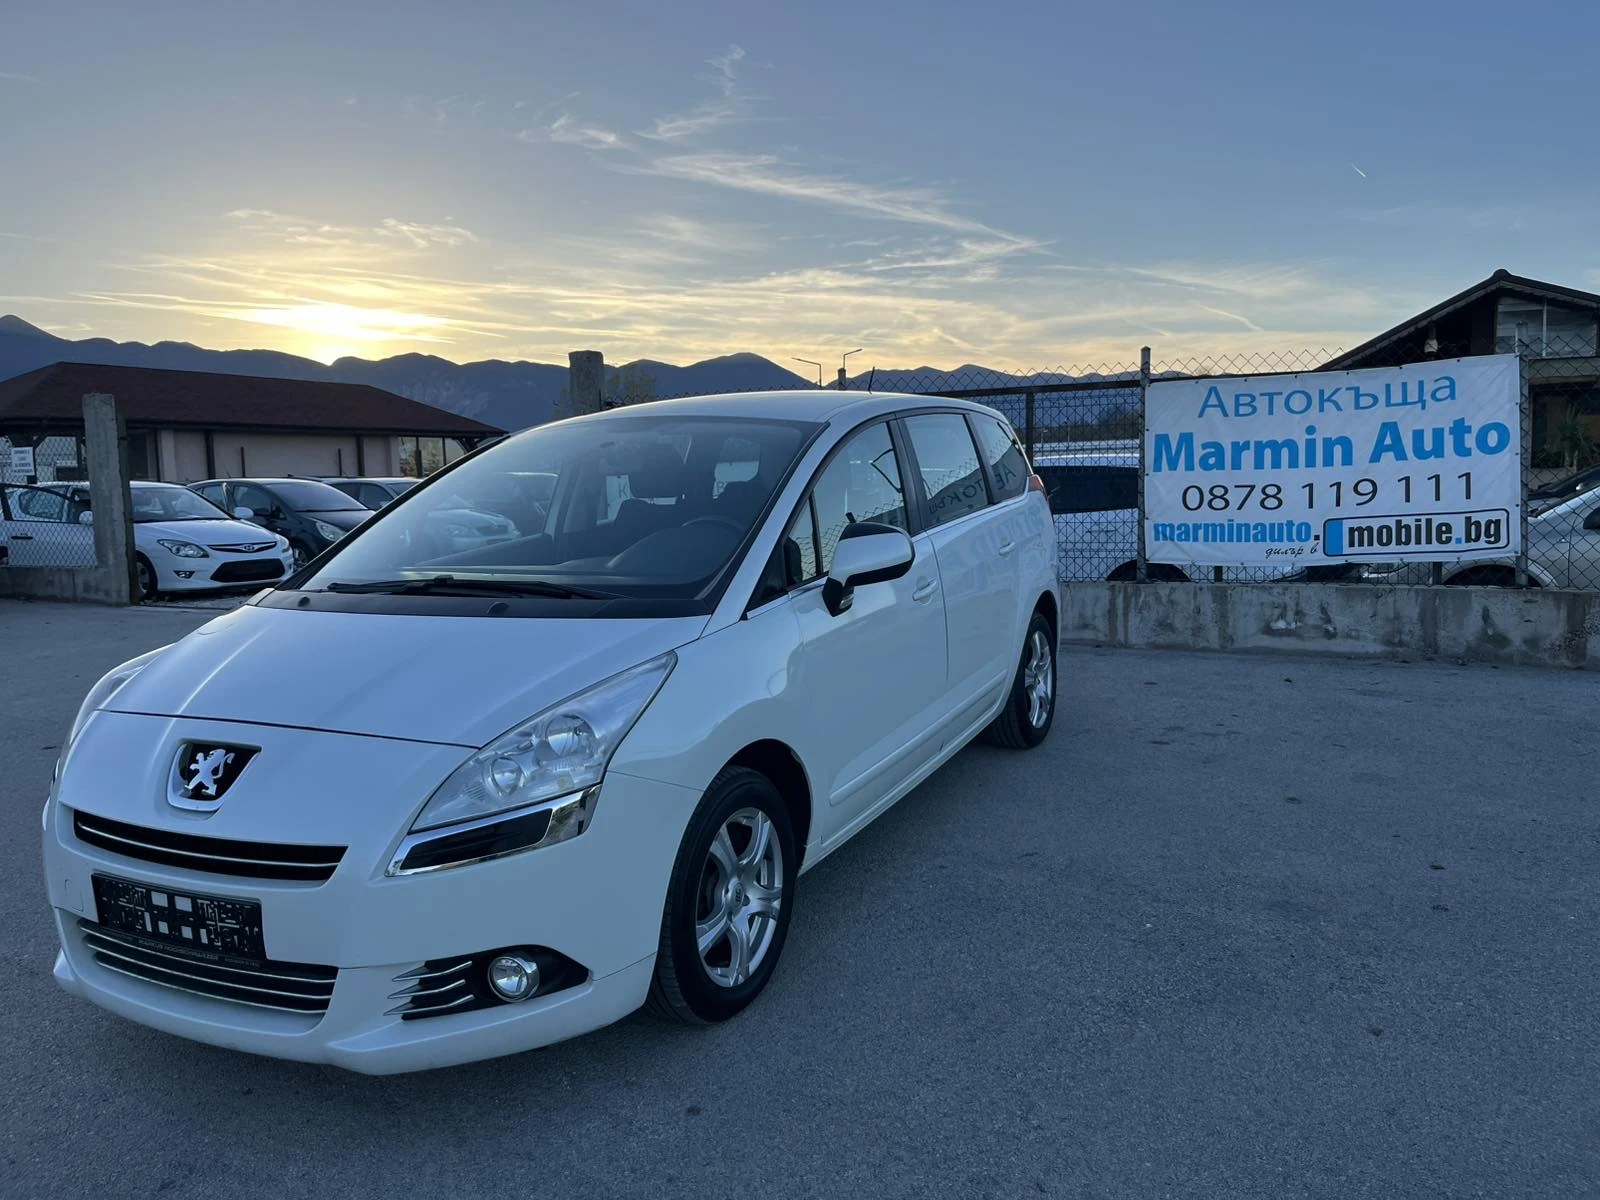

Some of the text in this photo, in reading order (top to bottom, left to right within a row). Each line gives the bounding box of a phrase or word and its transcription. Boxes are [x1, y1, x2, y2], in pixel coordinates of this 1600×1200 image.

[1152, 416, 1511, 473] Marmin Auto
[1181, 471, 1472, 512] 0878 119 111
[1347, 515, 1502, 549] mobile.bg
